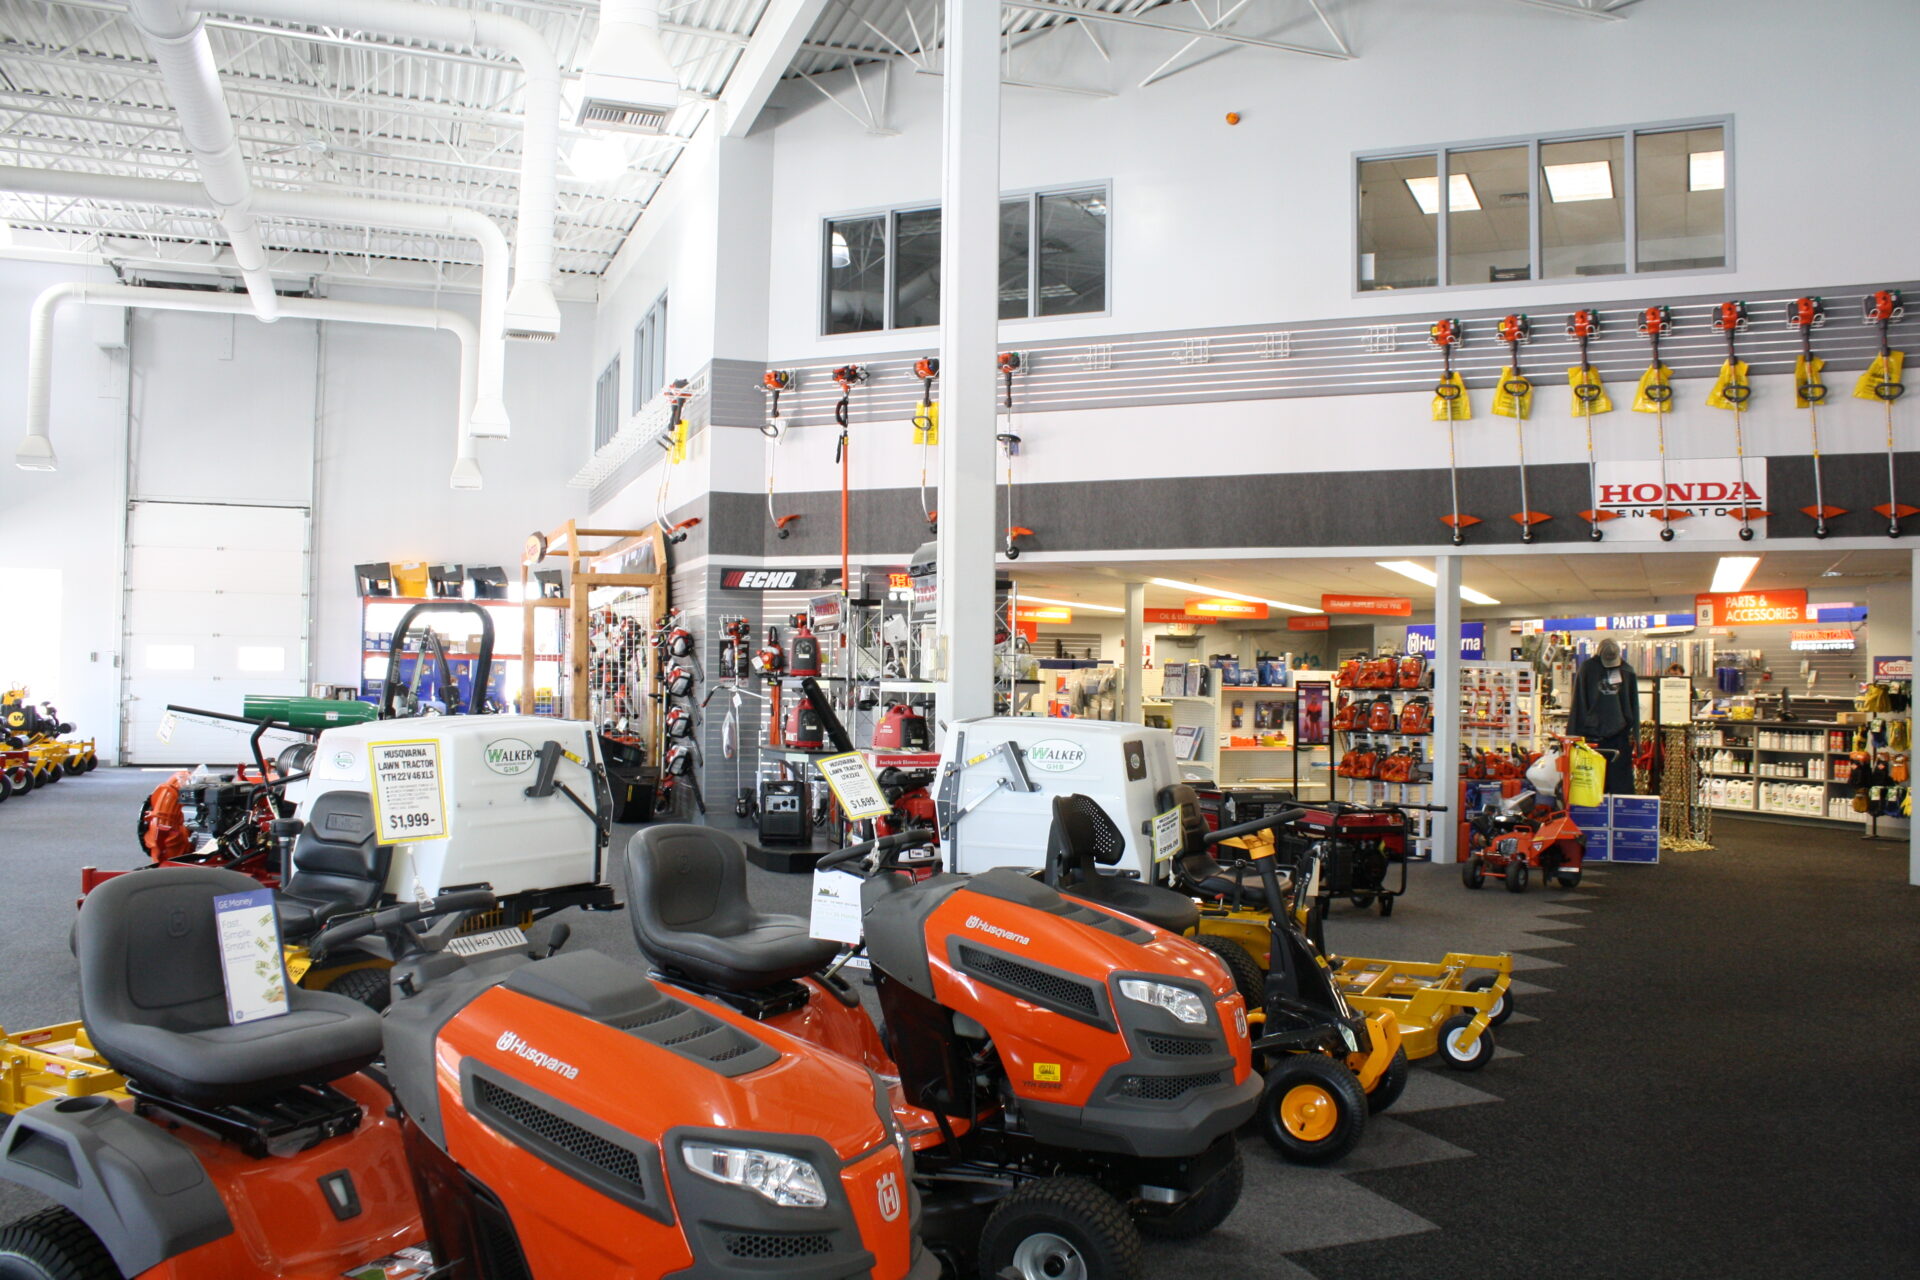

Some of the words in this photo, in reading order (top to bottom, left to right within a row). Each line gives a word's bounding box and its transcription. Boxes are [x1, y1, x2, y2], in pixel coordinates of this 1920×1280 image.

[1599, 482, 1762, 503] HONDA
[738, 571, 797, 588] ECHO
[1725, 594, 1757, 608] PARTS
[1758, 595, 1768, 607] &
[815, 603, 841, 616] HONDA
[1725, 607, 1799, 622] ACCESSORIES
[1612, 615, 1648, 629] PARTS
[1420, 635, 1481, 651] Hurna
[1878, 661, 1905, 676] Kinco
[384, 749, 427, 759] HUSQVARNA
[487, 748, 533, 763] WALKER
[1032, 747, 1083, 761] WALKER
[378, 761, 400, 771] LAWN
[402, 760, 434, 769] TRACTOR
[843, 764, 863, 772] TRACTOR
[218, 901, 229, 909] GE
[229, 897, 253, 907] Money
[976, 919, 1030, 945] Husqvarna
[474, 936, 496, 947] HOT
[509, 1038, 579, 1080] Husqvarna
